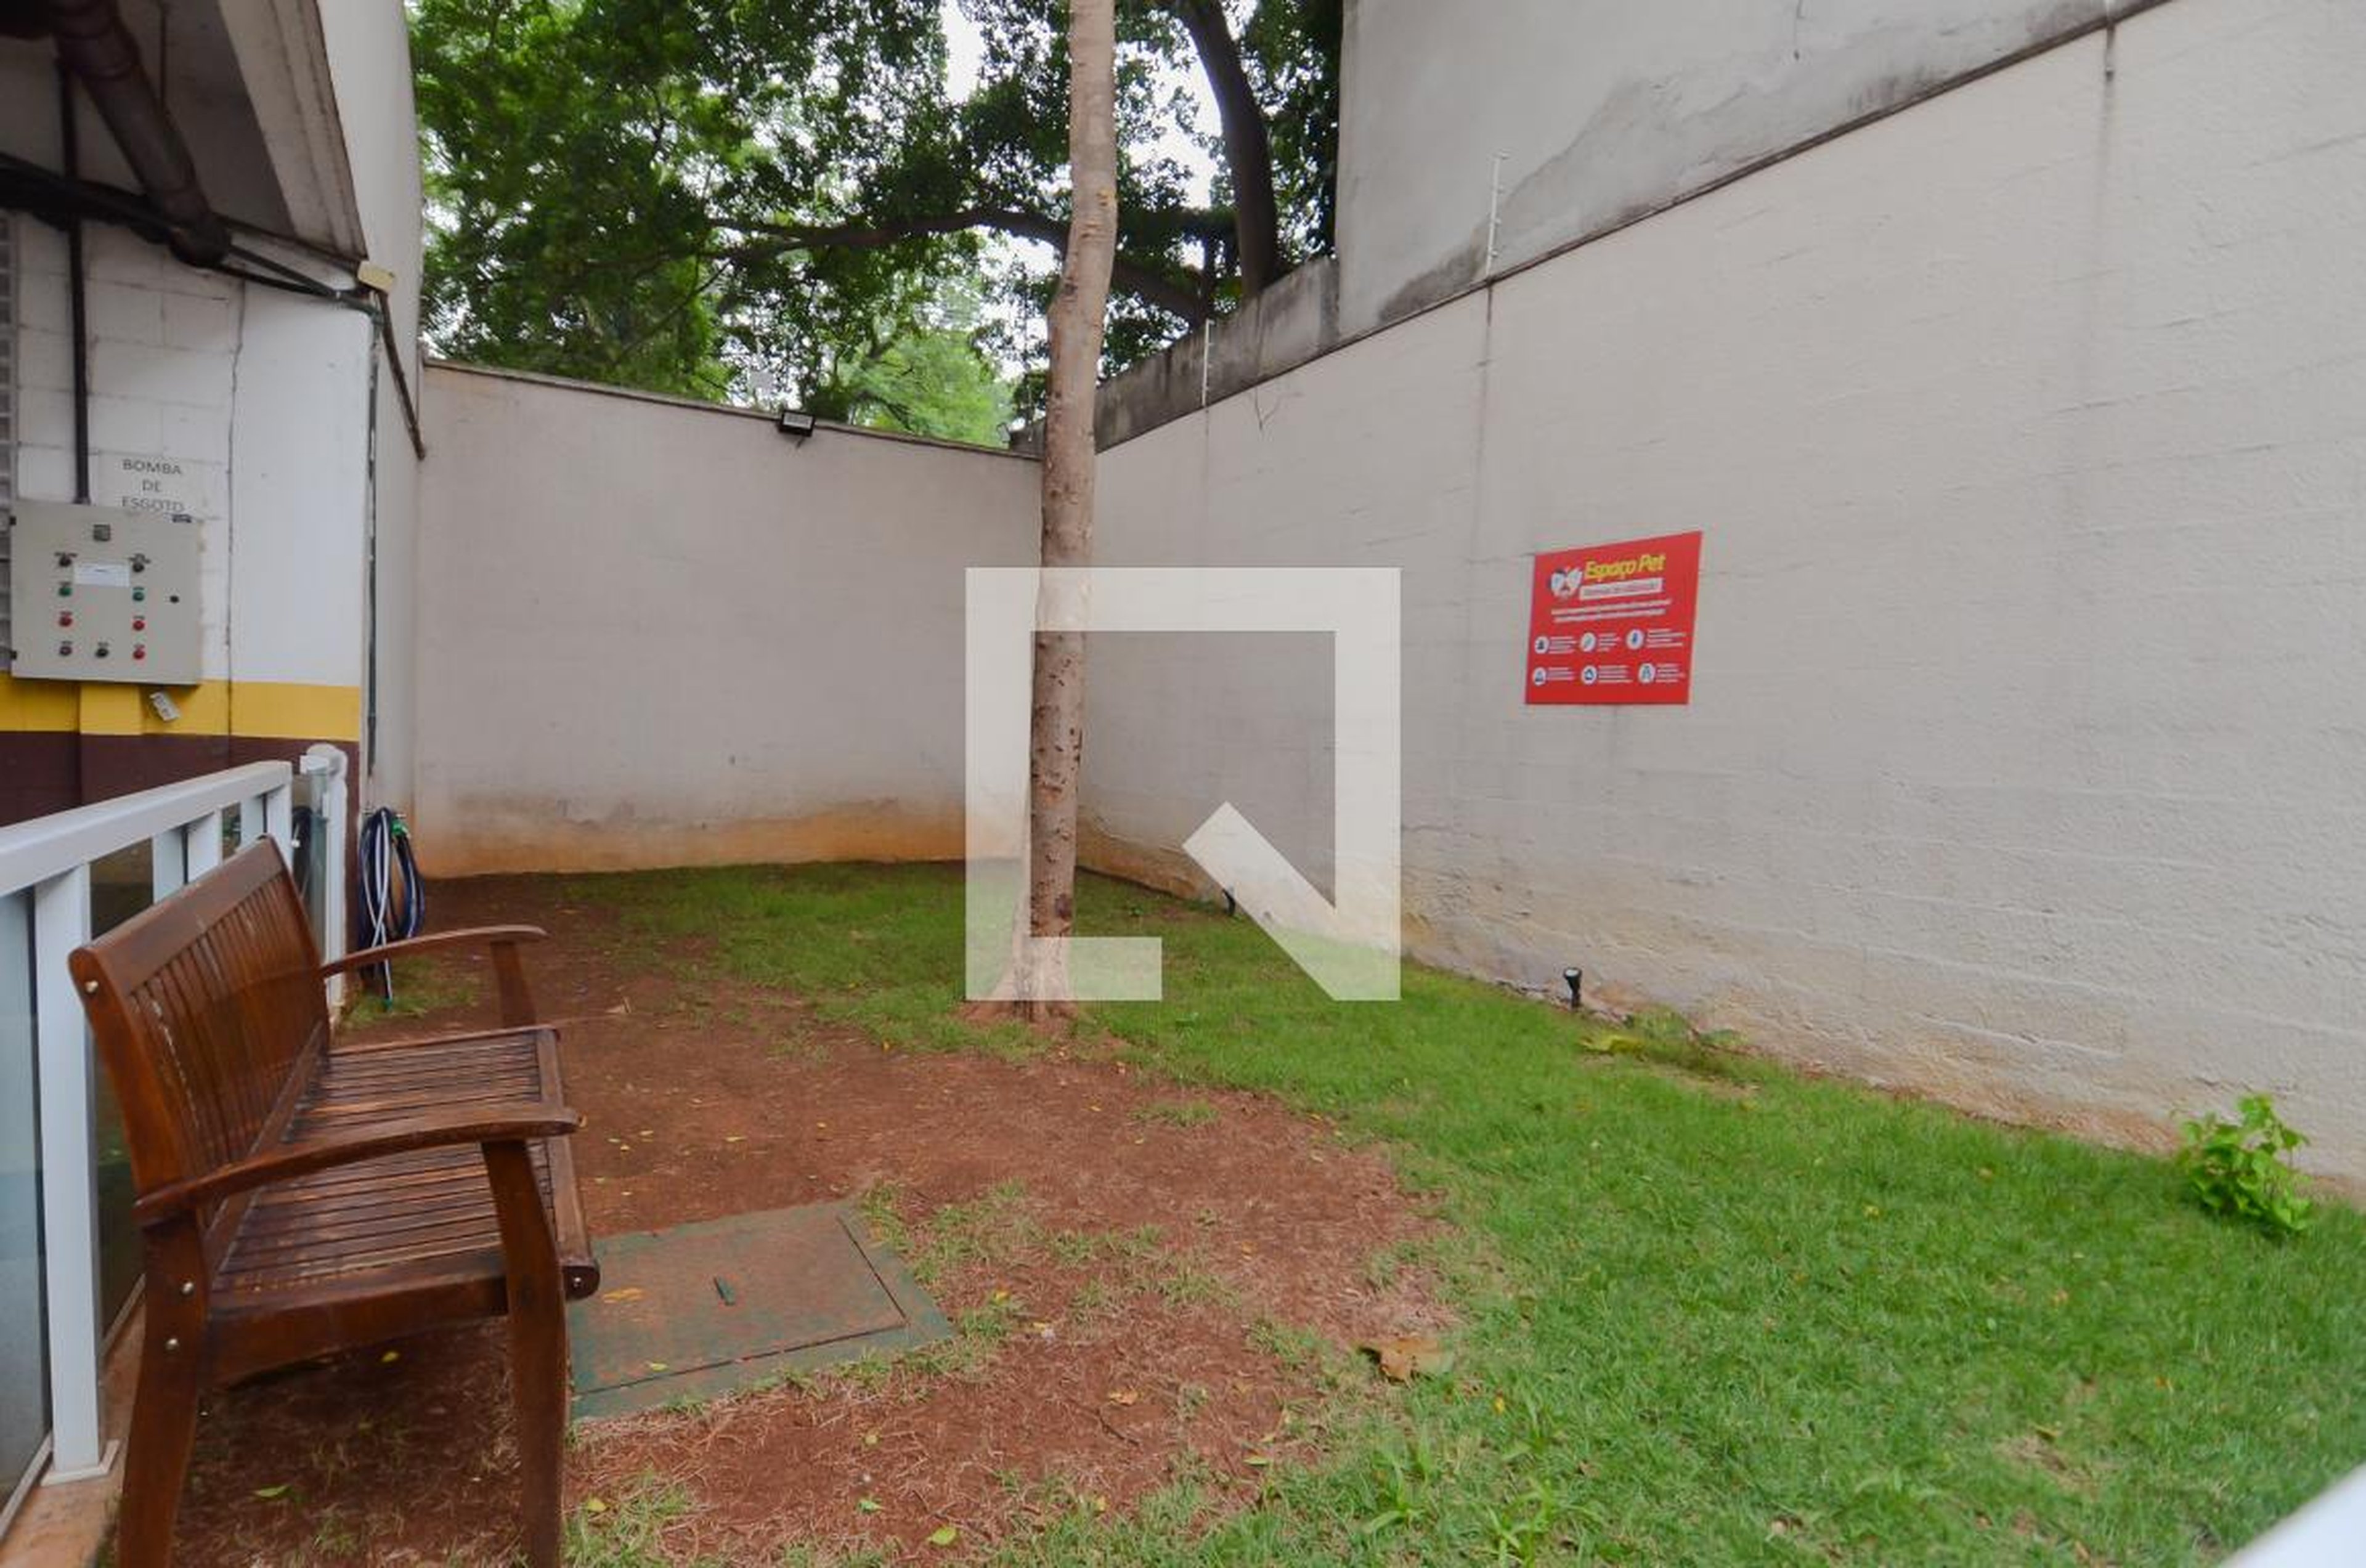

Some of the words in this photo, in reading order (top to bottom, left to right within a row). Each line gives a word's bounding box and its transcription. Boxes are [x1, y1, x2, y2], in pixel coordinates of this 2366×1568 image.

[123, 458, 182, 474] BOMBA
[142, 479, 161, 492] DE
[122, 495, 185, 513] ESGOTO
[1584, 559, 1637, 582] Espaço
[1638, 553, 1666, 572] Pet
